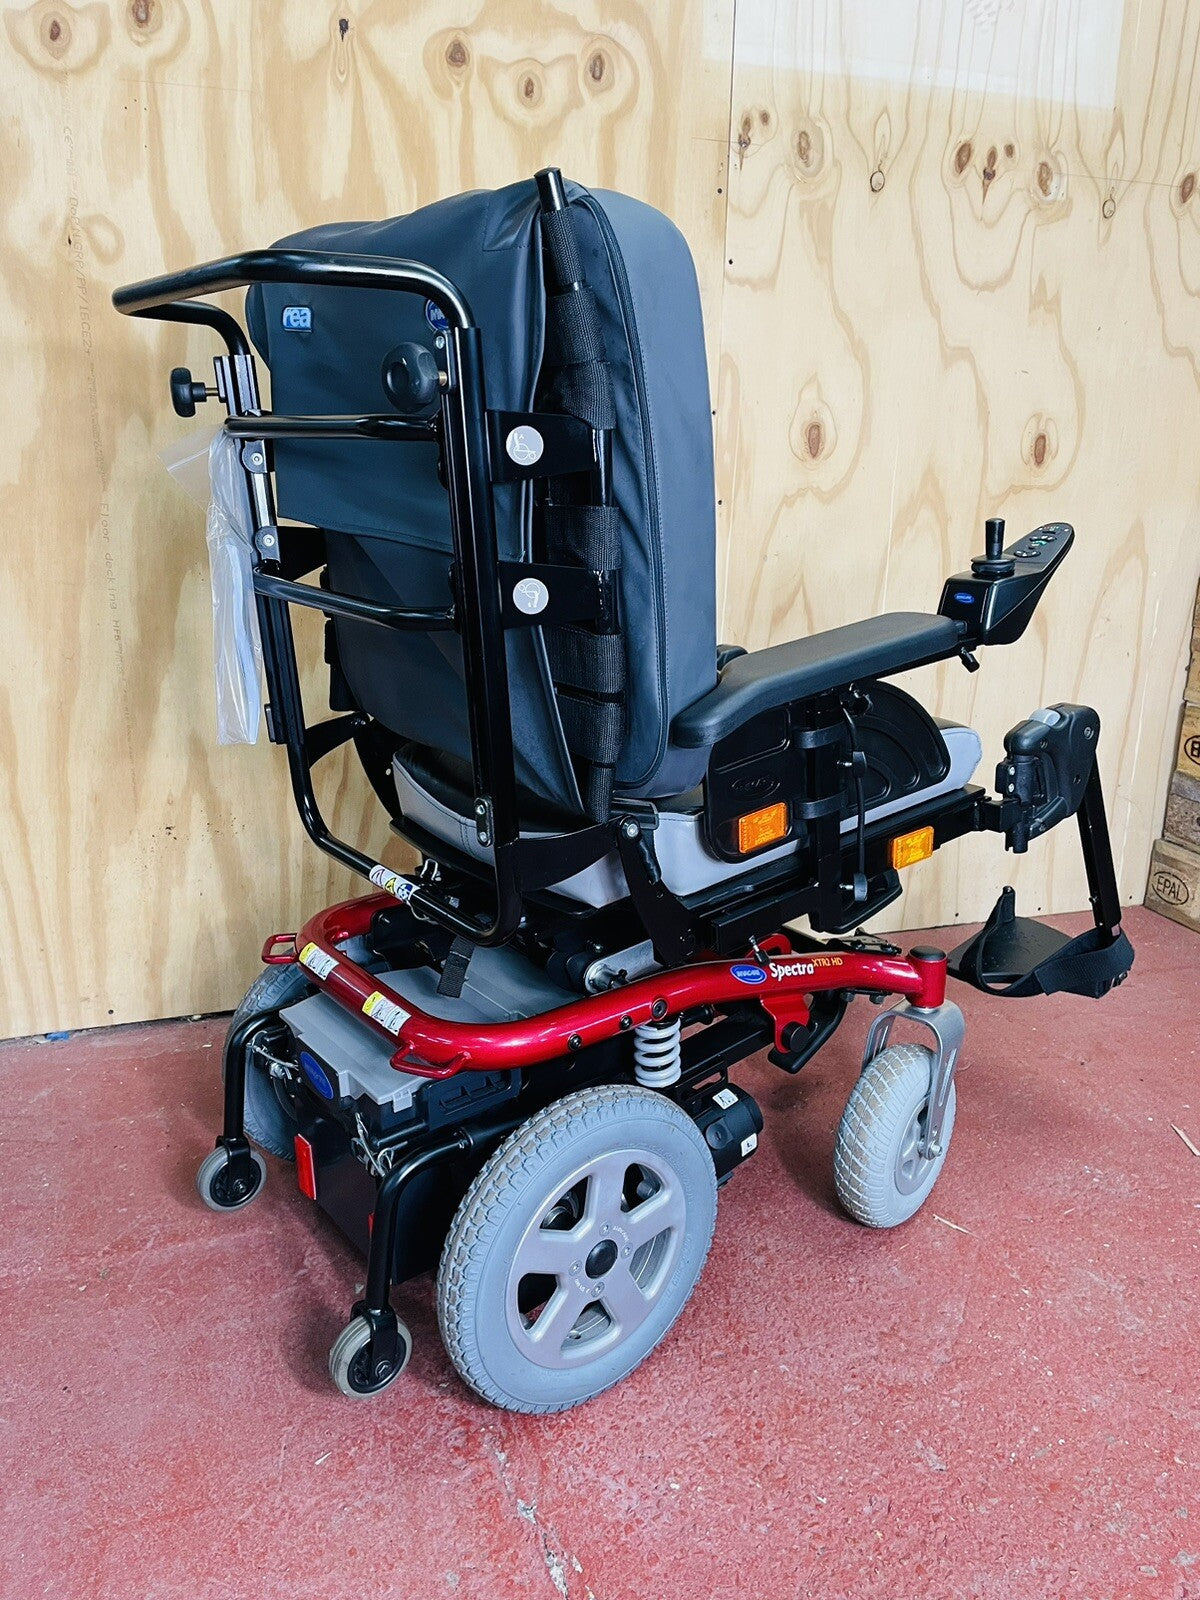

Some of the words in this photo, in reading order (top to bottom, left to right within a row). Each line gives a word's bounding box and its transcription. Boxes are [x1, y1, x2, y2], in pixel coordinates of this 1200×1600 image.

[283, 308, 312, 328] rea
[99, 503, 111, 542] Floor
[104, 552, 119, 611] decking
[1156, 875, 1182, 902] EPAL
[769, 962, 815, 982] Spectra
[811, 958, 831, 968] XTR2
[831, 957, 843, 966] HD
